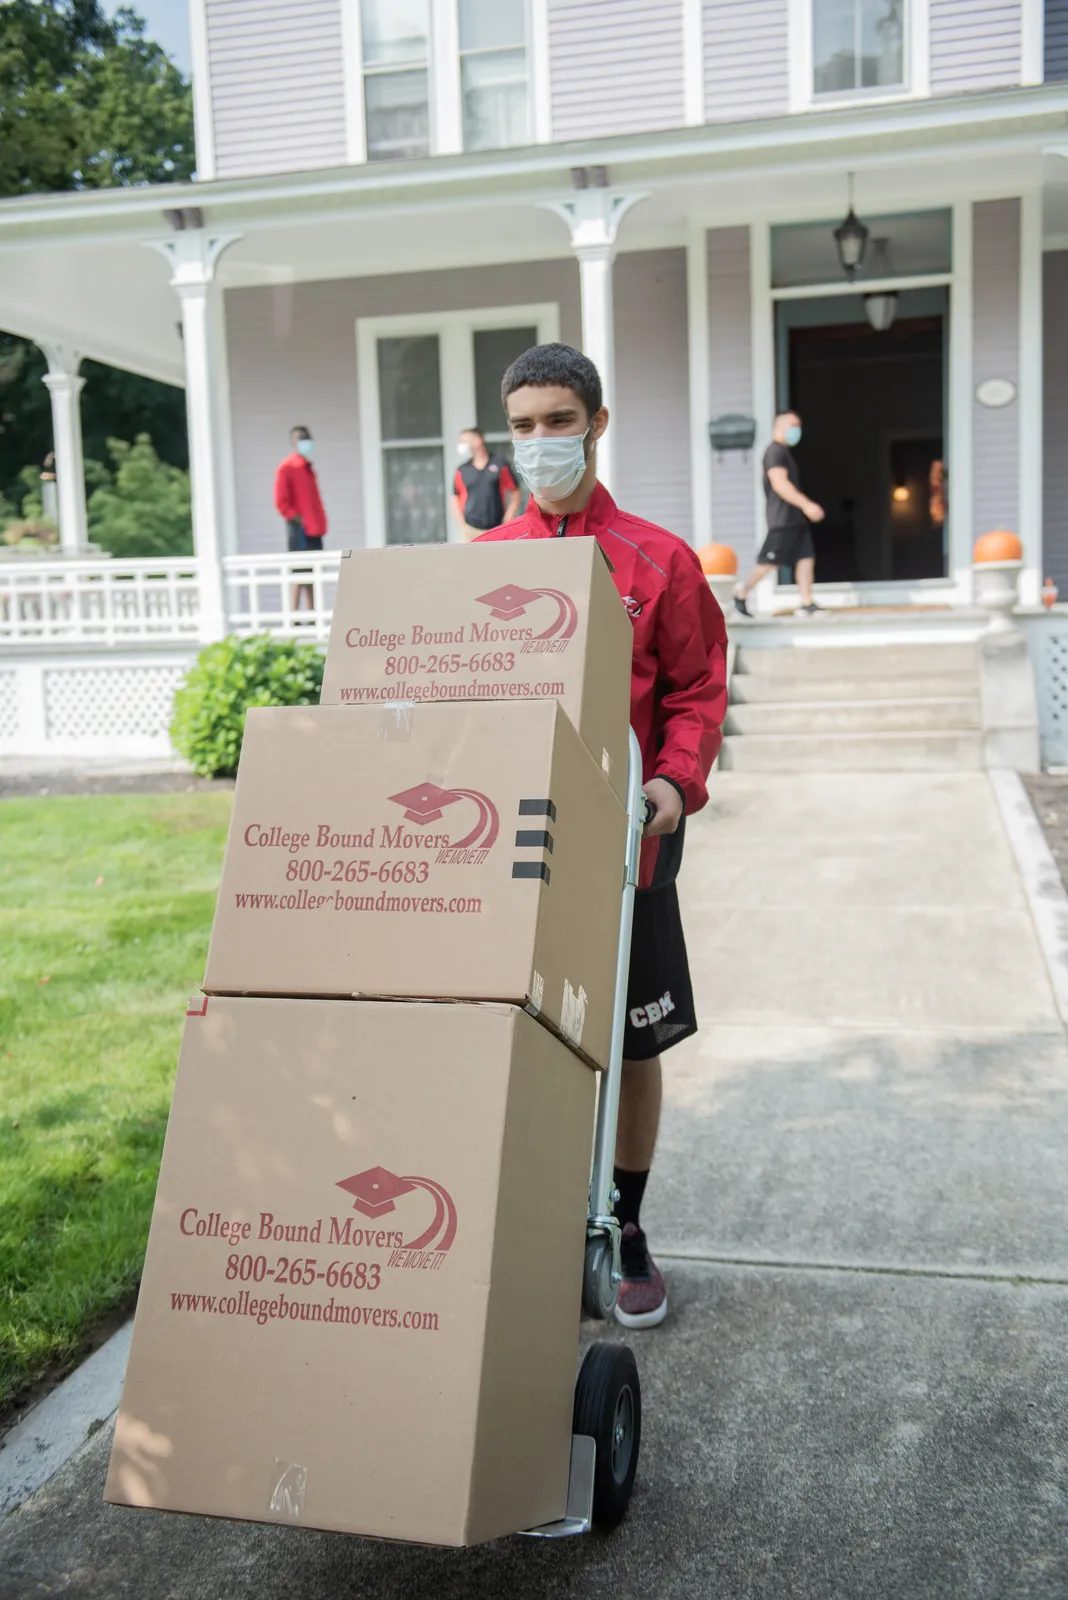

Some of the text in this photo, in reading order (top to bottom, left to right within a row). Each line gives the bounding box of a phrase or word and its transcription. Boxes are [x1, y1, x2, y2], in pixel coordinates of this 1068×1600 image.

[345, 622, 533, 651] College Bound Movers
[520, 640, 537, 653] WE
[384, 652, 515, 676] 800-265-6683
[340, 679, 565, 701] www.collegeboundmovers.com
[244, 823, 449, 853] College Bound Movers
[435, 849, 454, 864] WE
[448, 849, 479, 865] MOVE
[286, 859, 429, 883] 800-265-6683
[180, 1208, 403, 1249] College Bound Movers
[387, 1249, 408, 1268] WE
[402, 1250, 435, 1269] MOVE
[225, 1253, 381, 1290] 800-265-6683
[170, 1291, 440, 1331] www.collegeboundmovers.com
